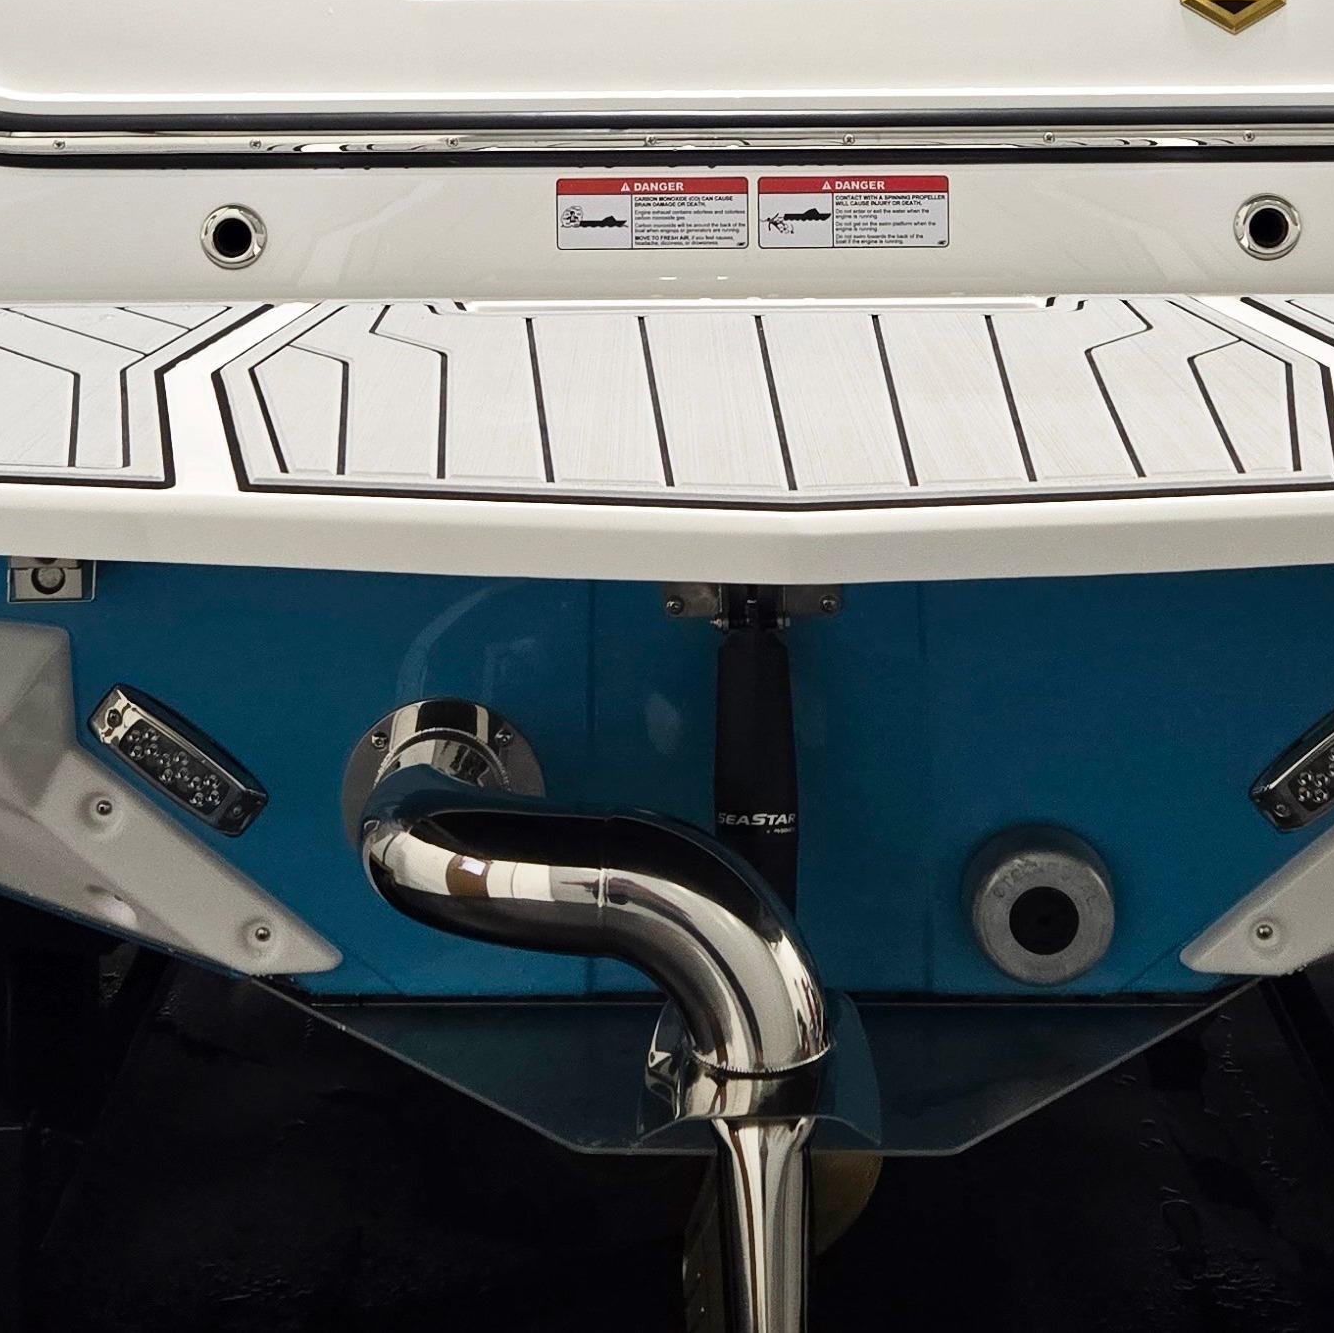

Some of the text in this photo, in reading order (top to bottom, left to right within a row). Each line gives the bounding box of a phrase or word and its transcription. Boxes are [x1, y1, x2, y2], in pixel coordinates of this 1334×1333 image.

[634, 182, 684, 191] DANGER
[835, 181, 885, 190] DANGER
[718, 813, 796, 825] SEASTAR
